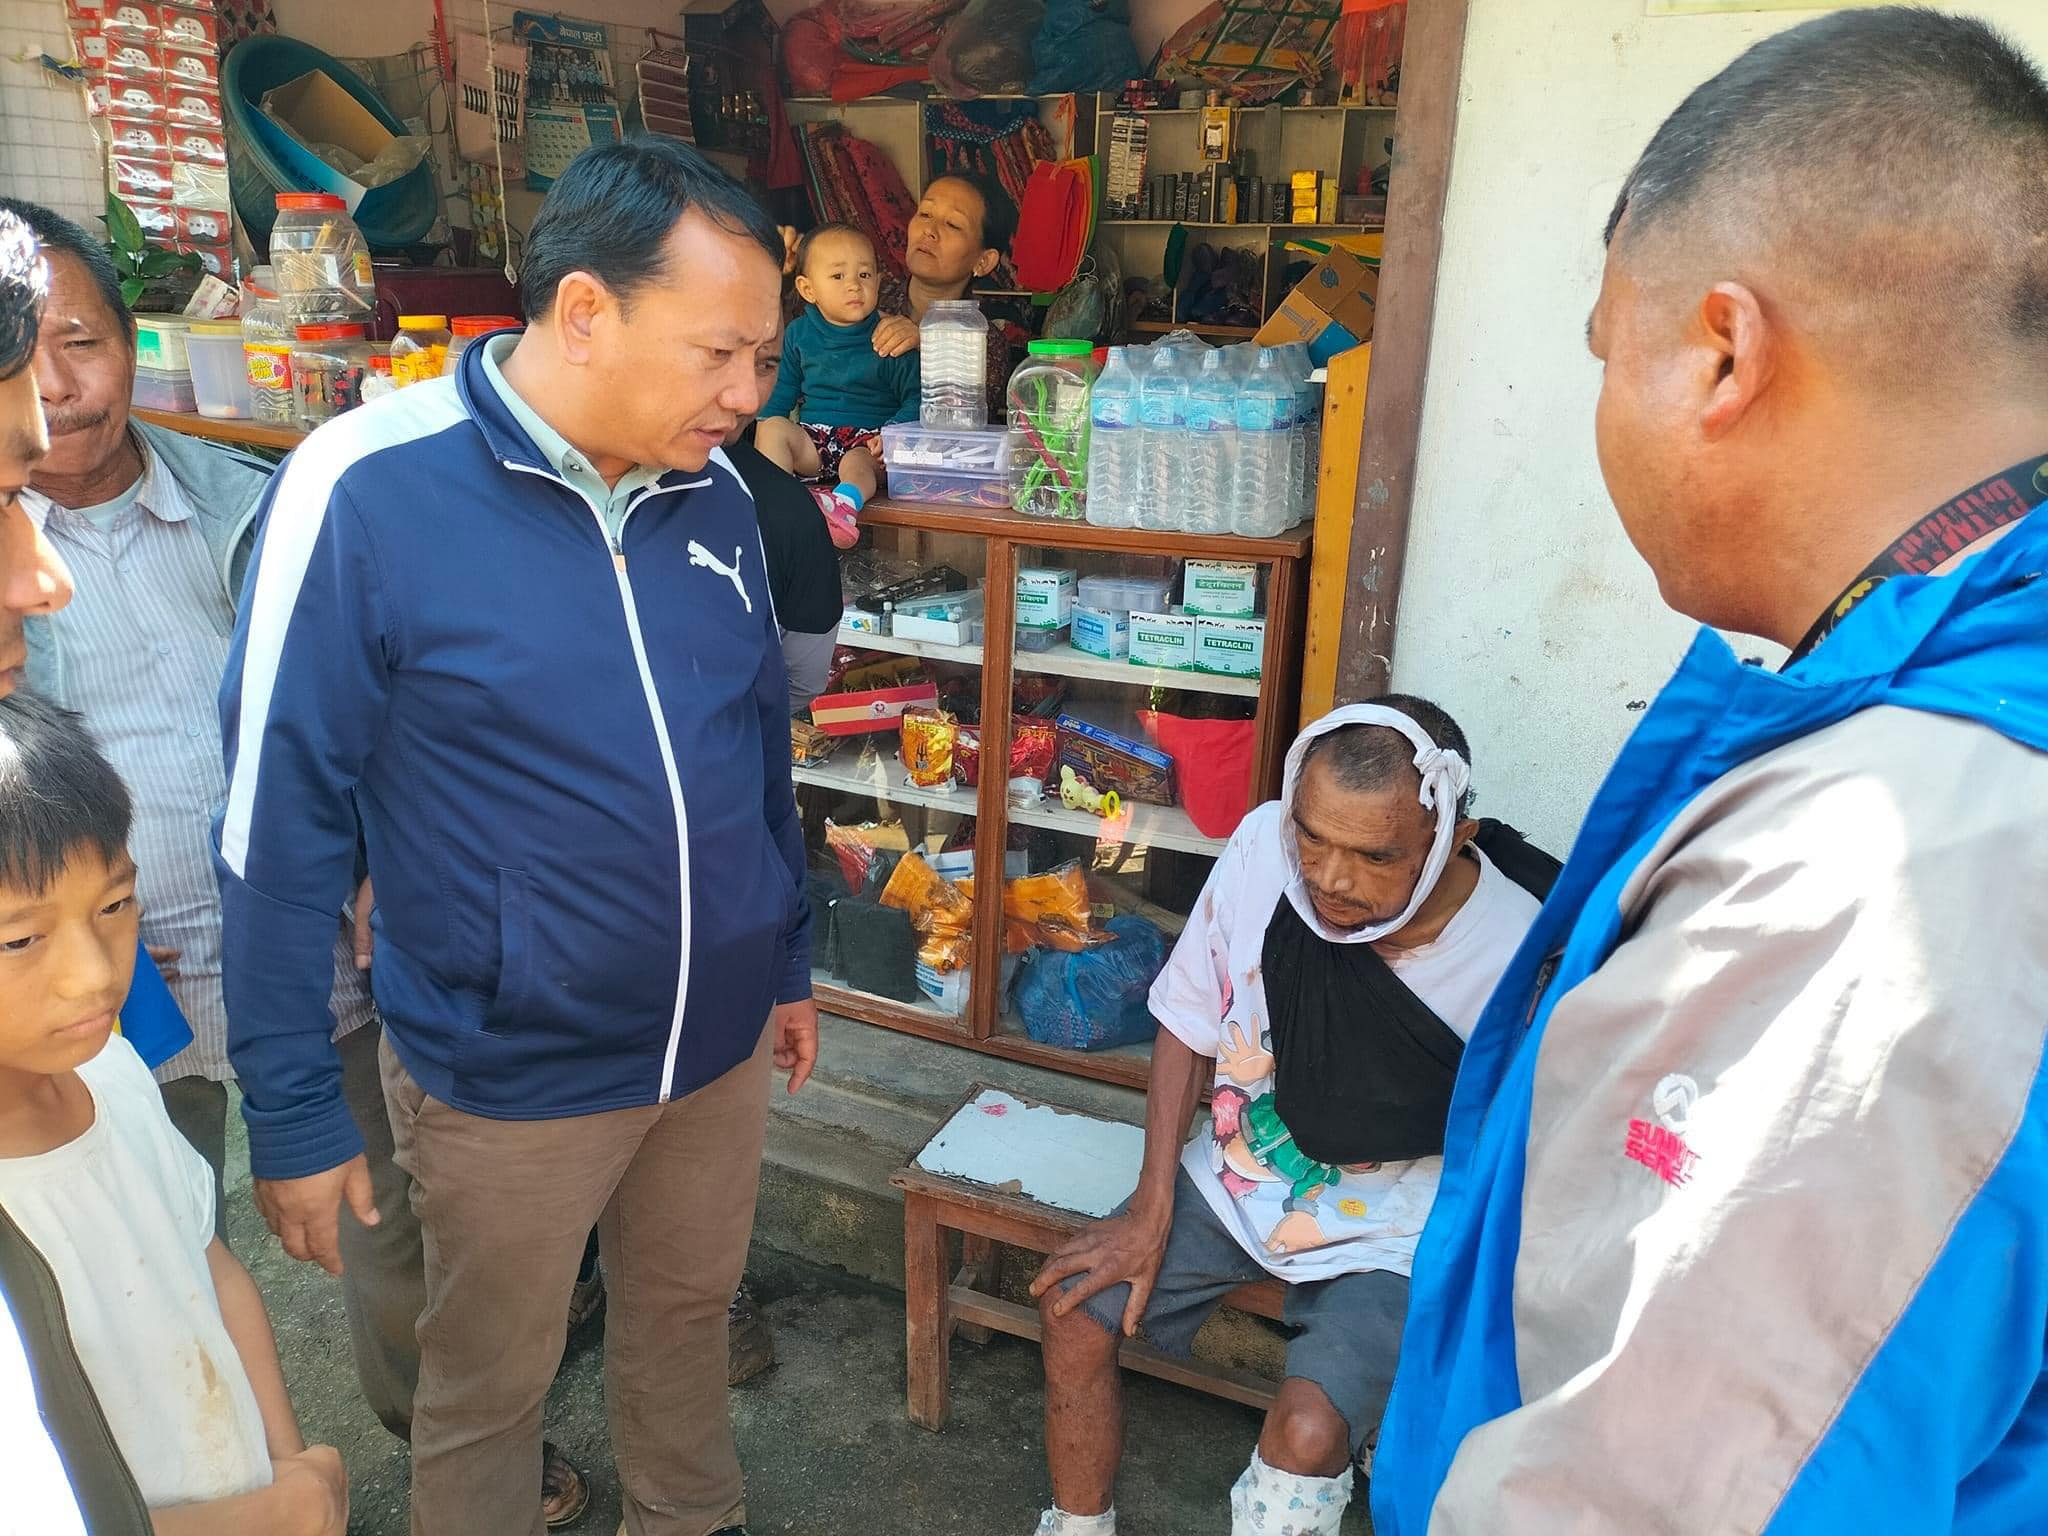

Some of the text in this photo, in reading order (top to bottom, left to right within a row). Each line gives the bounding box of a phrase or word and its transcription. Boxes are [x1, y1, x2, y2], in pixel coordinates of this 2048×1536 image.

[559, 26, 581, 39] नेपाल
[1140, 633, 1183, 645] TETRACLIN
[1206, 638, 1252, 651] TETRACLIN
